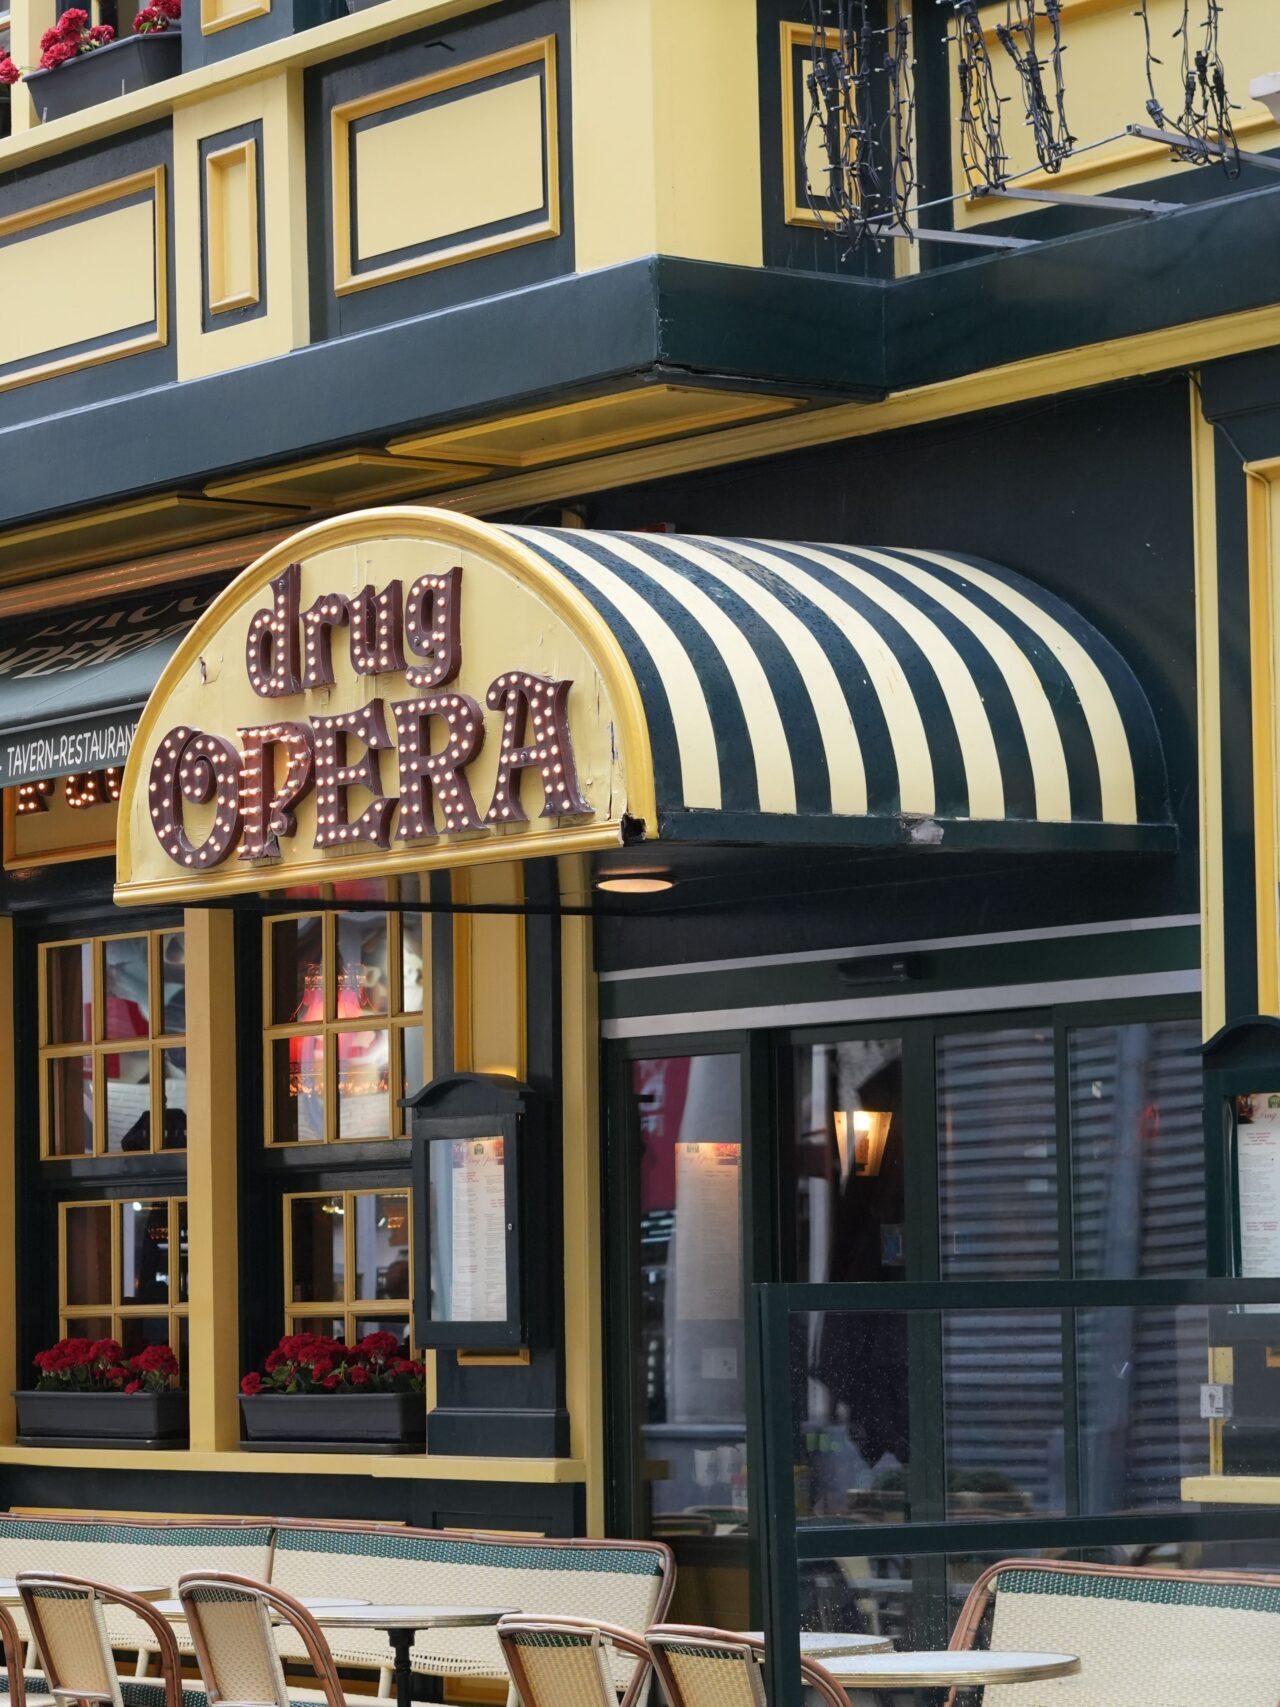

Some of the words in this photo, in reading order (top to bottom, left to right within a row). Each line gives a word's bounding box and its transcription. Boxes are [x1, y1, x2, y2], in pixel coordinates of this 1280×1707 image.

[246, 563, 463, 699] drug
[7, 723, 138, 777] TAVERN-RESTAURAN
[149, 671, 595, 869] OPERA
